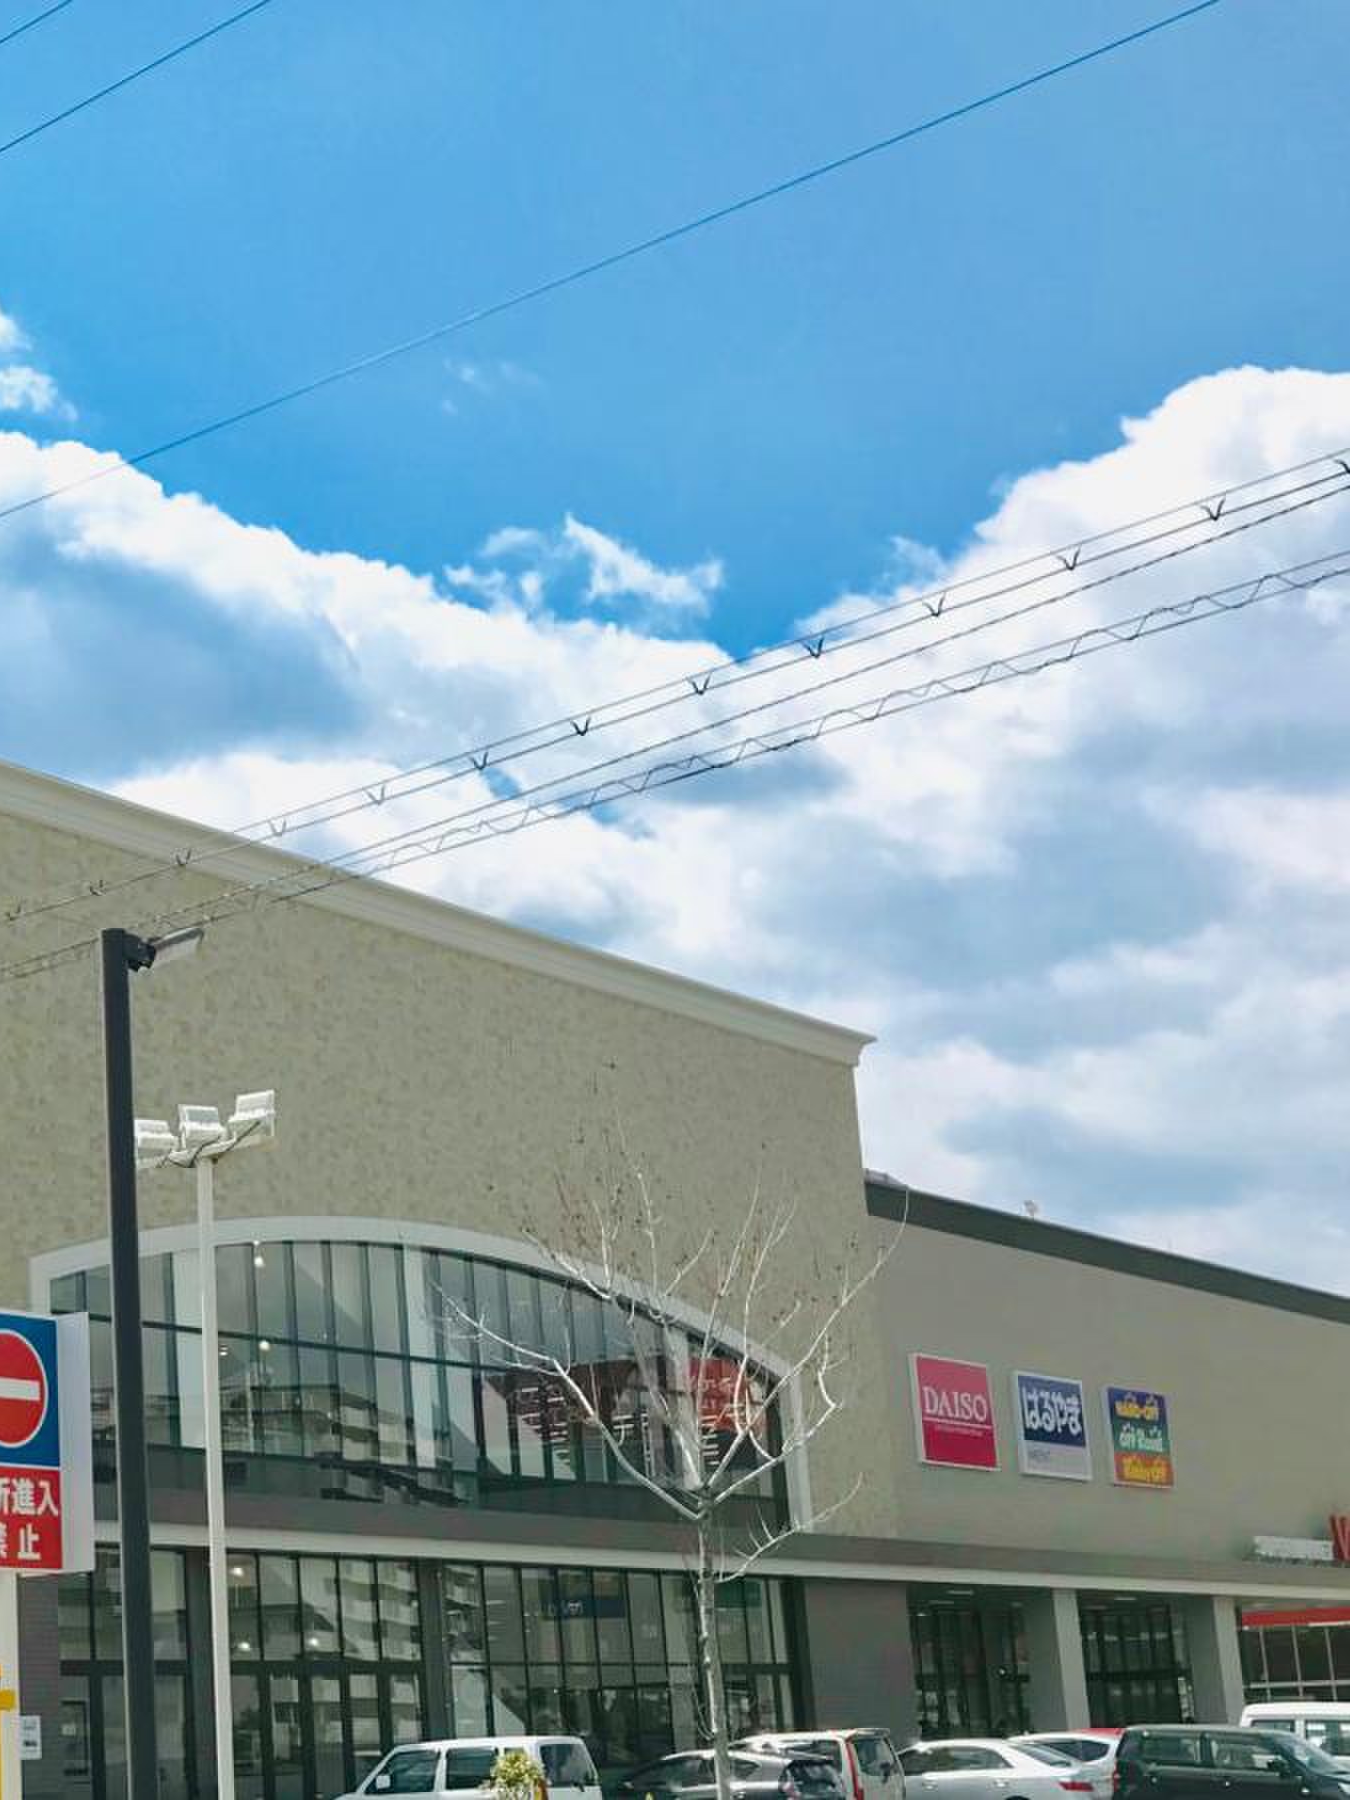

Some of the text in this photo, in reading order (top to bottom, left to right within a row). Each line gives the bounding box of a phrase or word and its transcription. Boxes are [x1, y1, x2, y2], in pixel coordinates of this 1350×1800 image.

[922, 1386, 988, 1422] DAISO
[1022, 1386, 1082, 1436] はるやま
